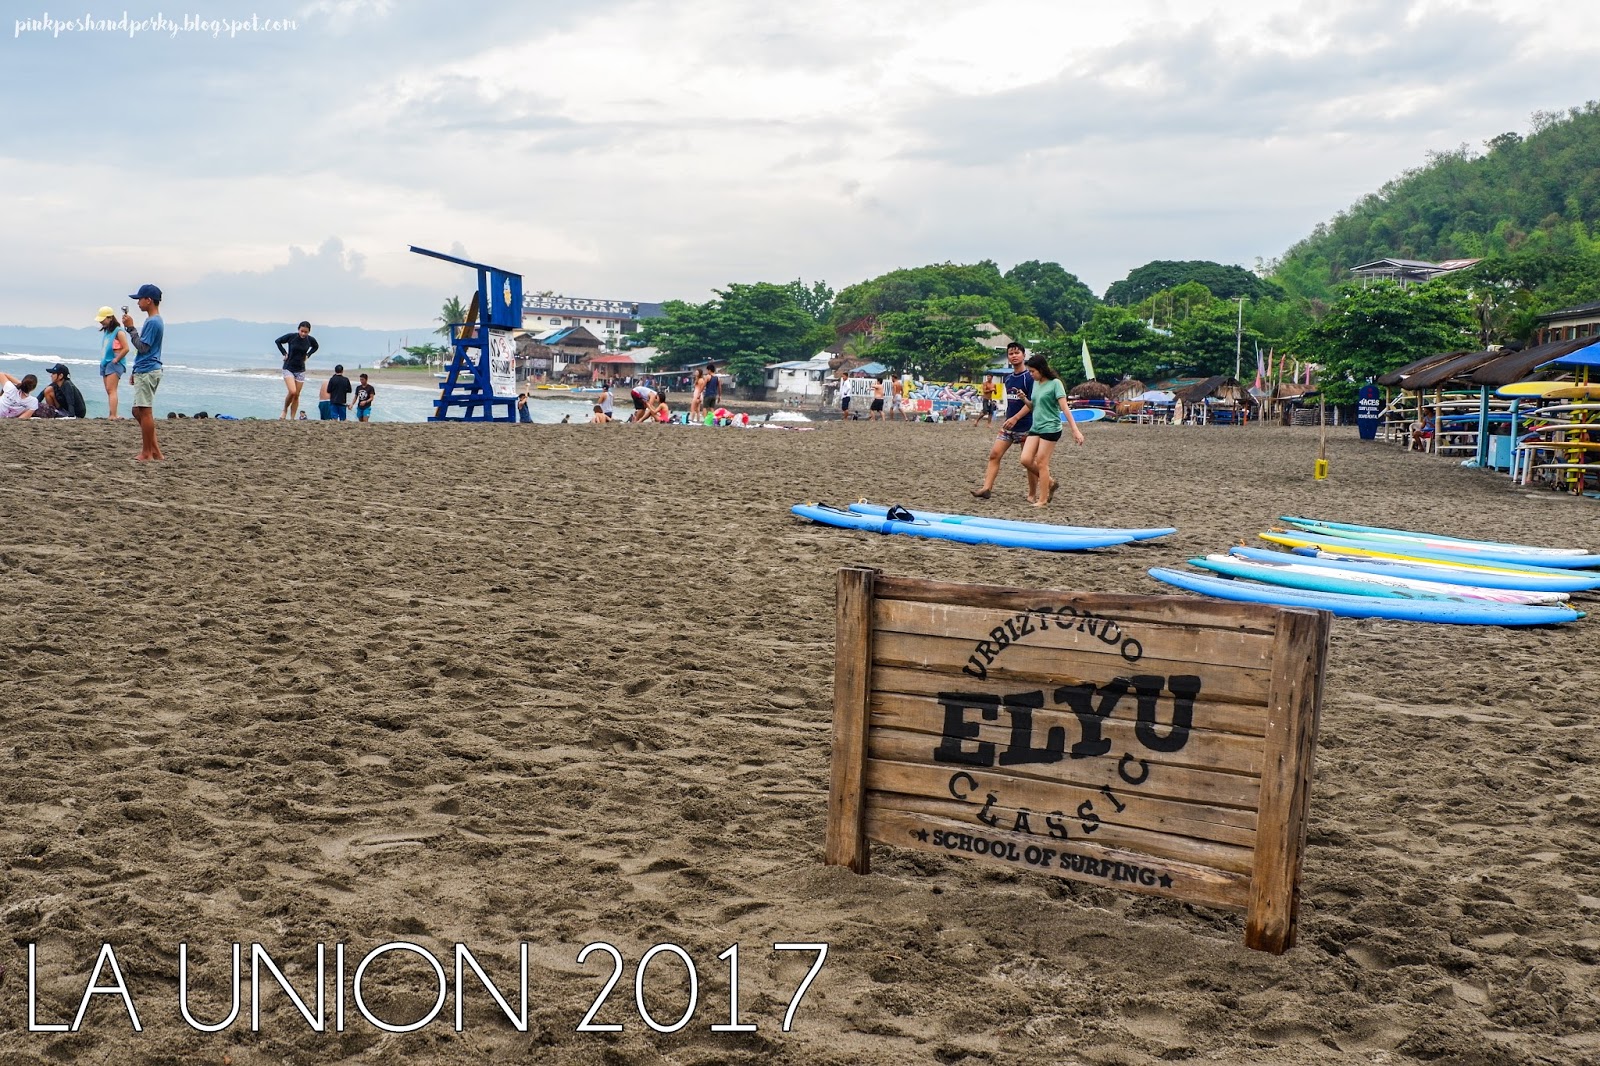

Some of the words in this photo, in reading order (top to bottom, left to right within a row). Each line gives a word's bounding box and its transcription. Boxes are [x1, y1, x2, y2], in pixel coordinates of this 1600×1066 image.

[525, 296, 623, 307] RESORT
[962, 606, 1142, 680] URBIZTONDO
[933, 674, 1201, 767] ELYU
[948, 752, 1149, 839] CLASSIC
[933, 829, 1020, 862] SCHOOL
[1024, 845, 1057, 867] OF
[1060, 852, 1159, 886] SURFING
